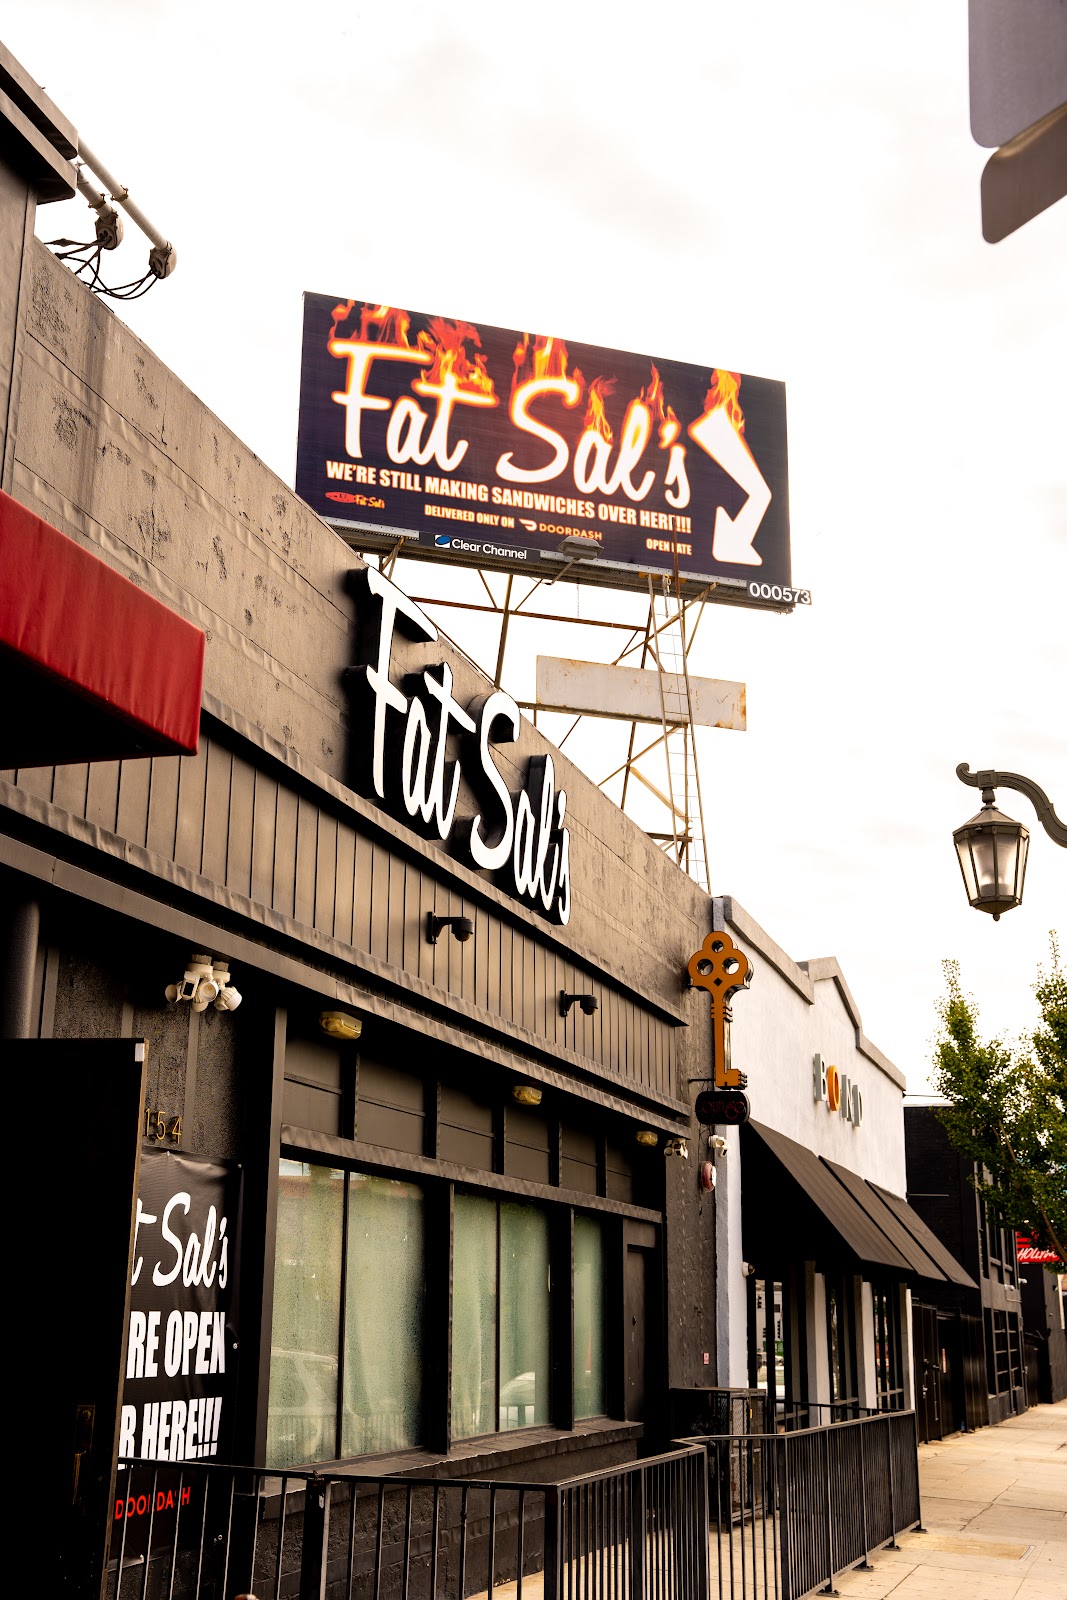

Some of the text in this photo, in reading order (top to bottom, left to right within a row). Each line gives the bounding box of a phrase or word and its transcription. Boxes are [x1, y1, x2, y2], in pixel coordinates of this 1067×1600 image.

[329, 339, 690, 509] Fat Sal's
[326, 460, 376, 486] WE'RE
[379, 469, 422, 492] STILL
[424, 475, 489, 503] MAKING
[491, 485, 596, 519] SANDWICHES
[598, 503, 637, 526] OVER
[424, 504, 603, 541] DELIVERED ONLY ON DOORDASH
[451, 538, 527, 560] Clear Channel
[645, 537, 671, 553] OPEN
[749, 582, 811, 606] 000573
[364, 565, 571, 926] Fat Sal's
[814, 1053, 863, 1127] BOND
[152, 1191, 229, 1289] Sal's
[164, 1310, 226, 1378] OPEN
[140, 1397, 223, 1462] HERE!!!
